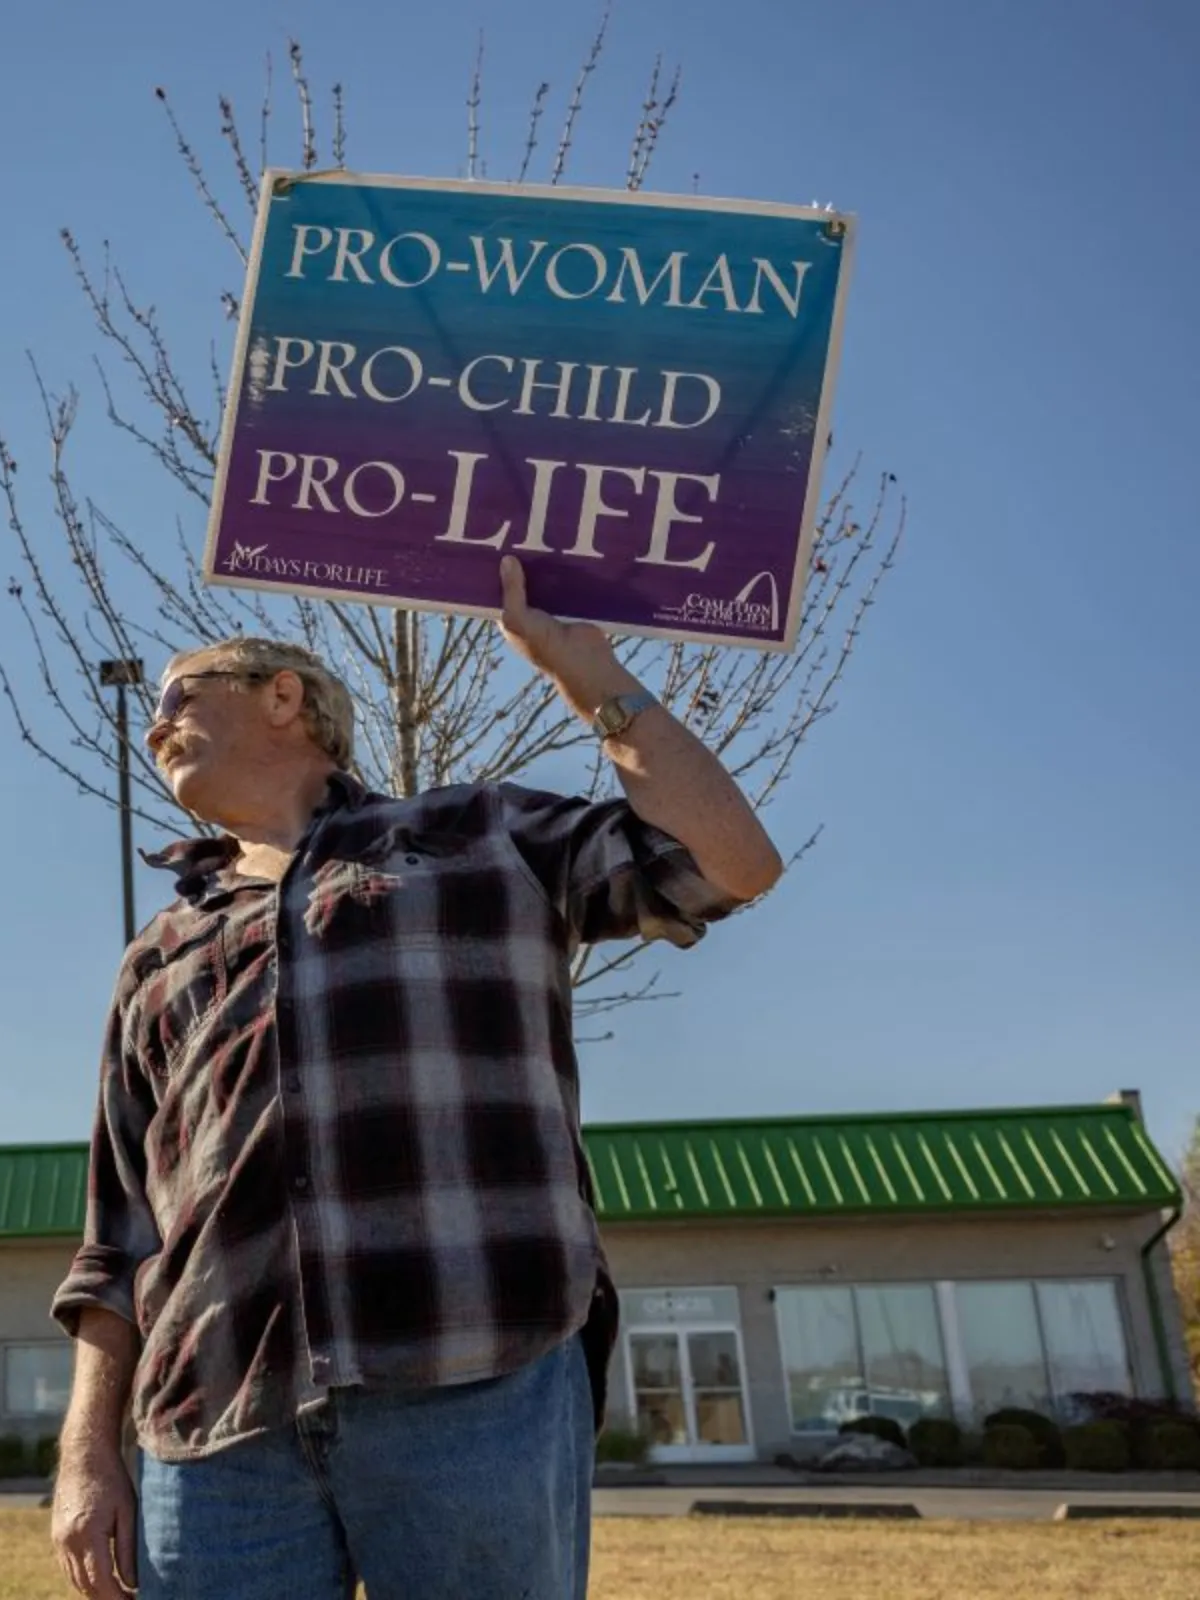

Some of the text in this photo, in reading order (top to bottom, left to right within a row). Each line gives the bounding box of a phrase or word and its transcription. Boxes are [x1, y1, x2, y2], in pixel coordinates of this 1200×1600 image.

[284, 222, 813, 319] PRO-WOMAN
[266, 336, 721, 430] PRO-CHILD
[248, 449, 721, 573] PRO-LIFE
[254, 555, 301, 577] DAYS
[303, 560, 344, 582] FOR
[345, 566, 391, 588] LIFE
